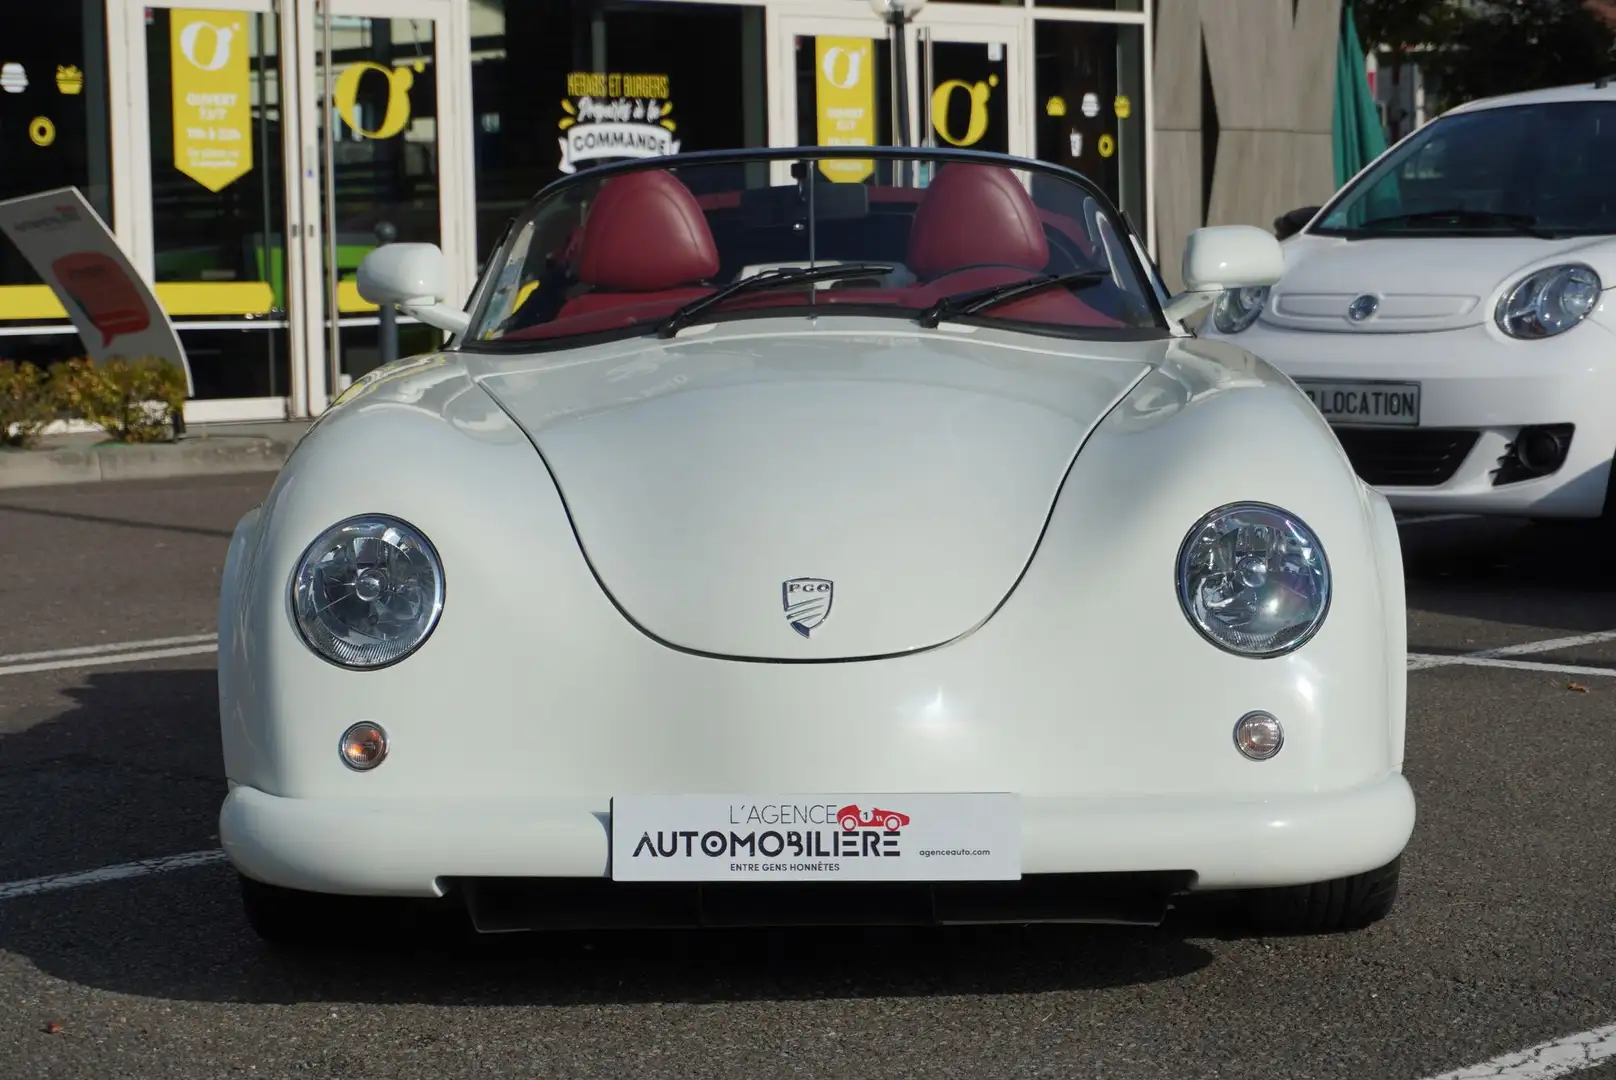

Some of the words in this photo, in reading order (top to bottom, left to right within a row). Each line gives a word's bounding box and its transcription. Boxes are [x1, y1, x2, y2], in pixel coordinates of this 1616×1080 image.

[623, 74, 669, 99] BURGERS
[574, 131, 666, 155] COMMANDE
[1321, 390, 1414, 416] LOCATION
[789, 583, 830, 593] PGO
[730, 804, 837, 825] L'AGENCE
[919, 848, 991, 858] agenceauto.com
[730, 863, 760, 872] ENTRE
[762, 863, 788, 872] GENS
[789, 861, 840, 872] HONNÊTES
